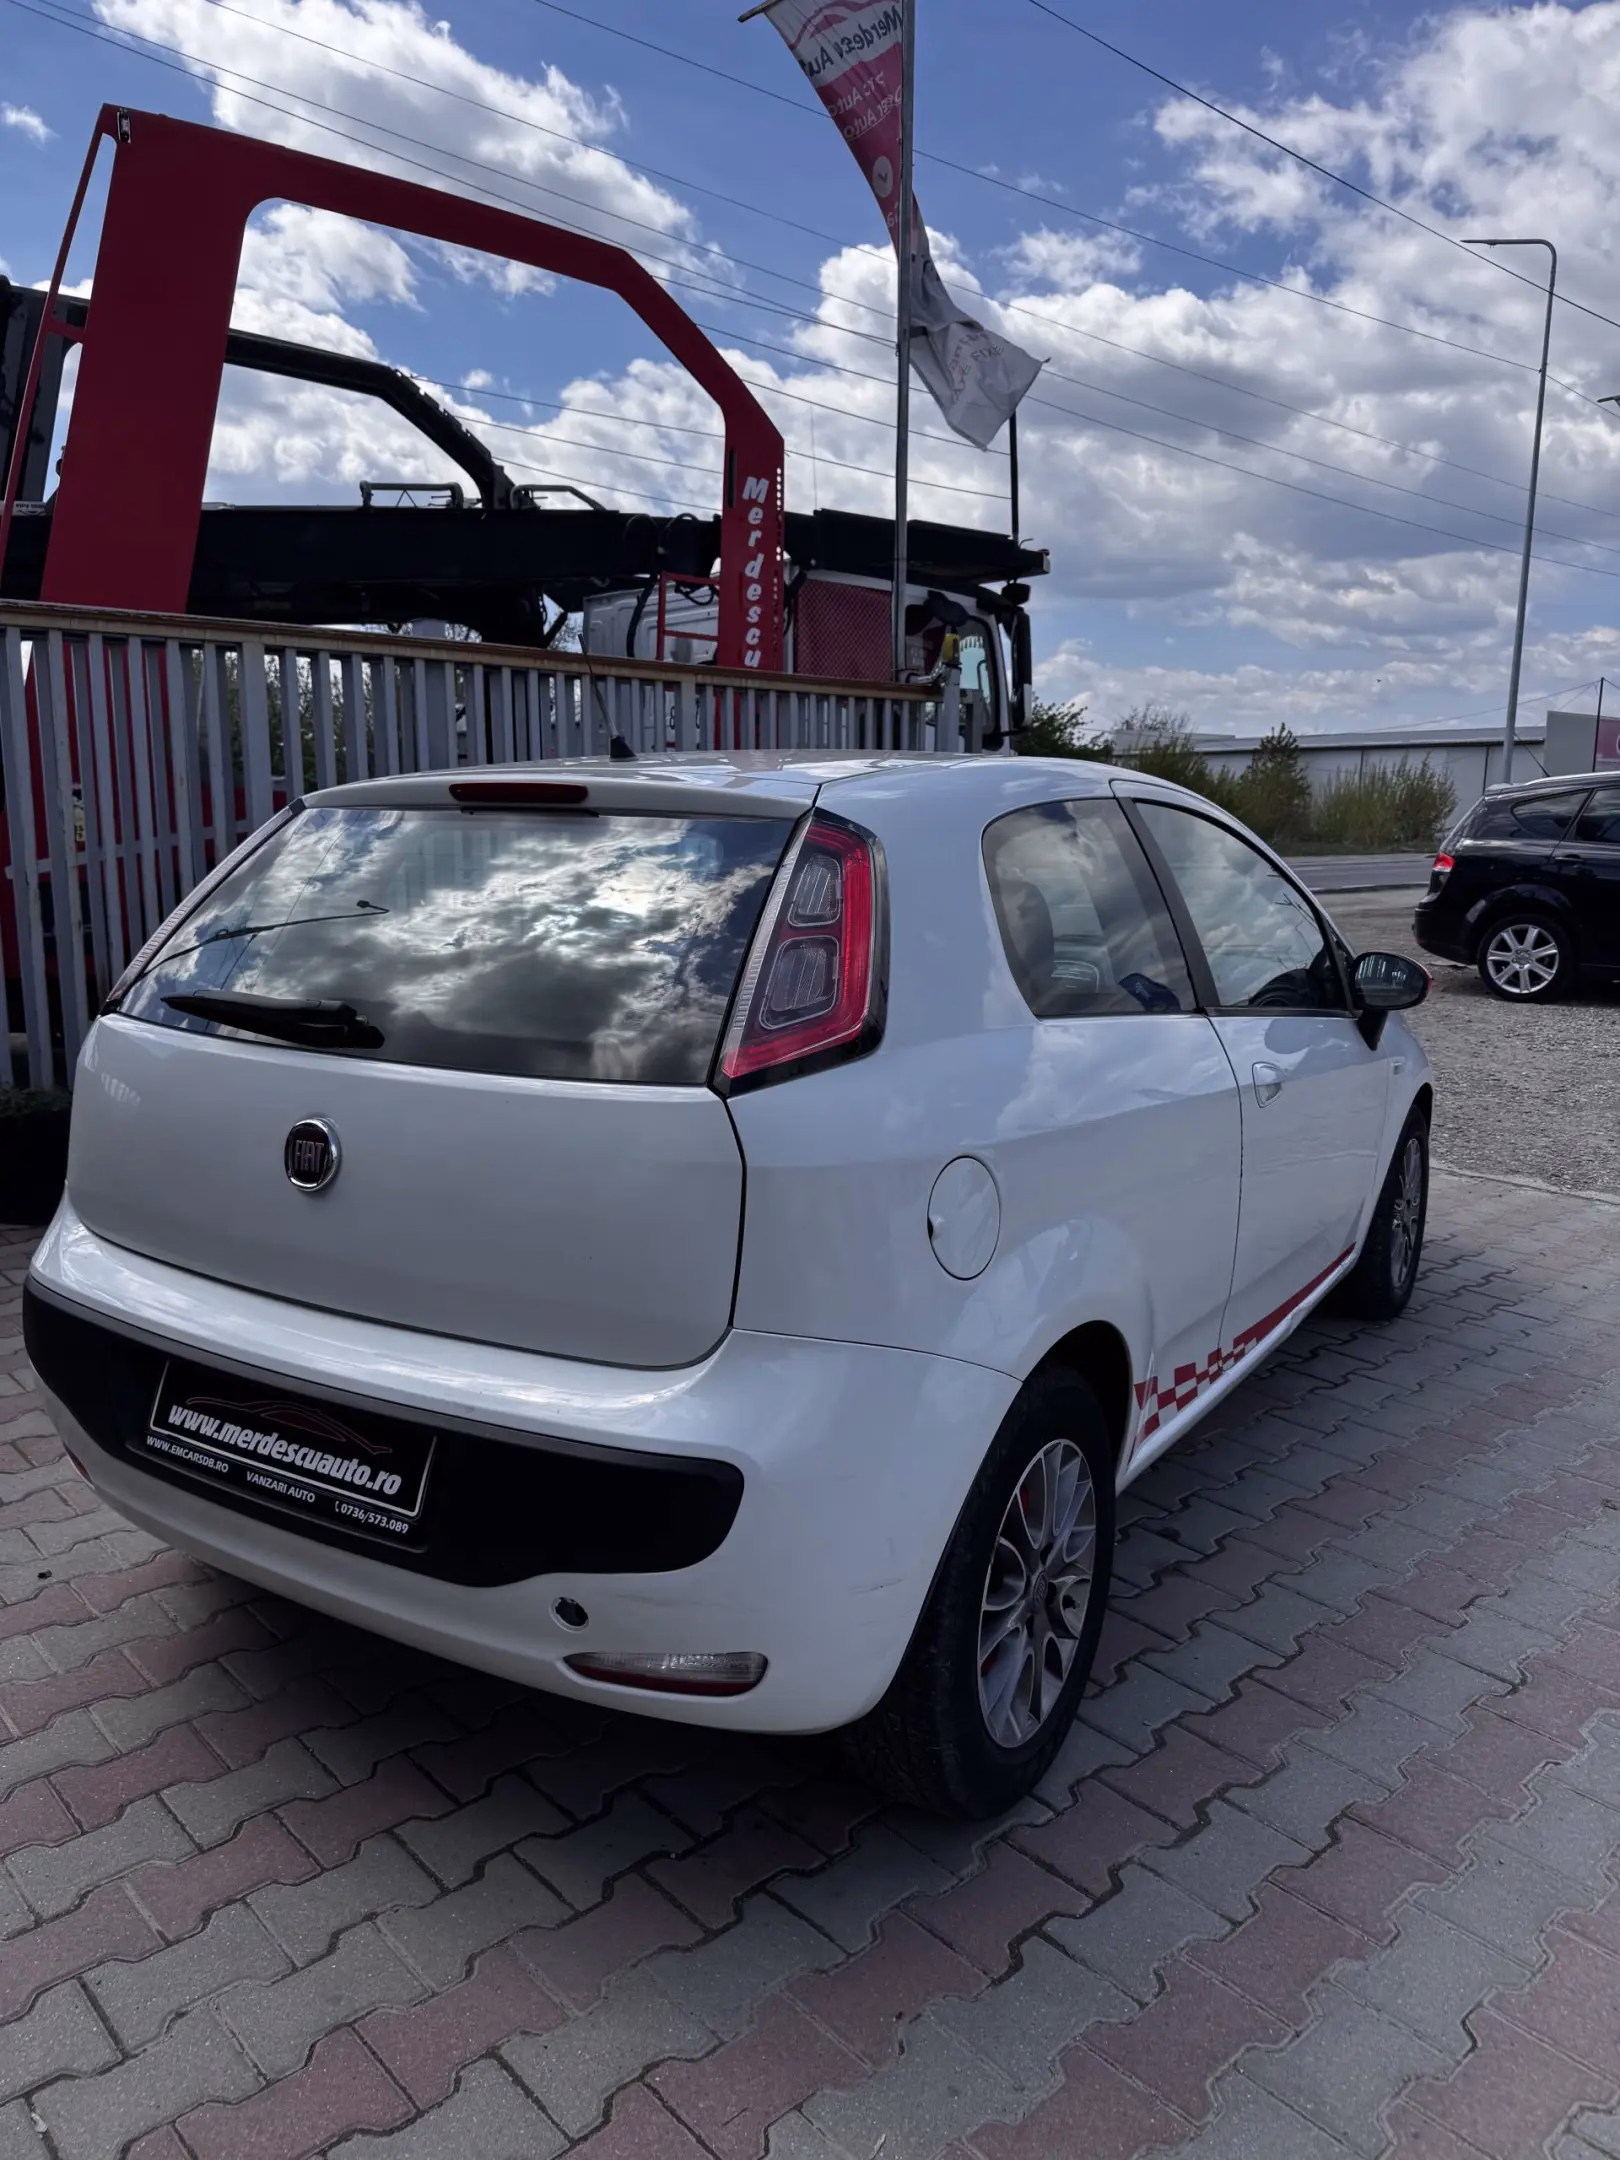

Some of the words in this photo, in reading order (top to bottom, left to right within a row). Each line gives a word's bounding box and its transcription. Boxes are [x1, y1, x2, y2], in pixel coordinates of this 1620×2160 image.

[741, 475, 770, 668] Merdescu
[294, 1139, 325, 1173] FIAT
[168, 1404, 402, 1495] www.merdescuauto.ro
[246, 1470, 287, 1494] VANZARI
[287, 1486, 316, 1503] AUTO
